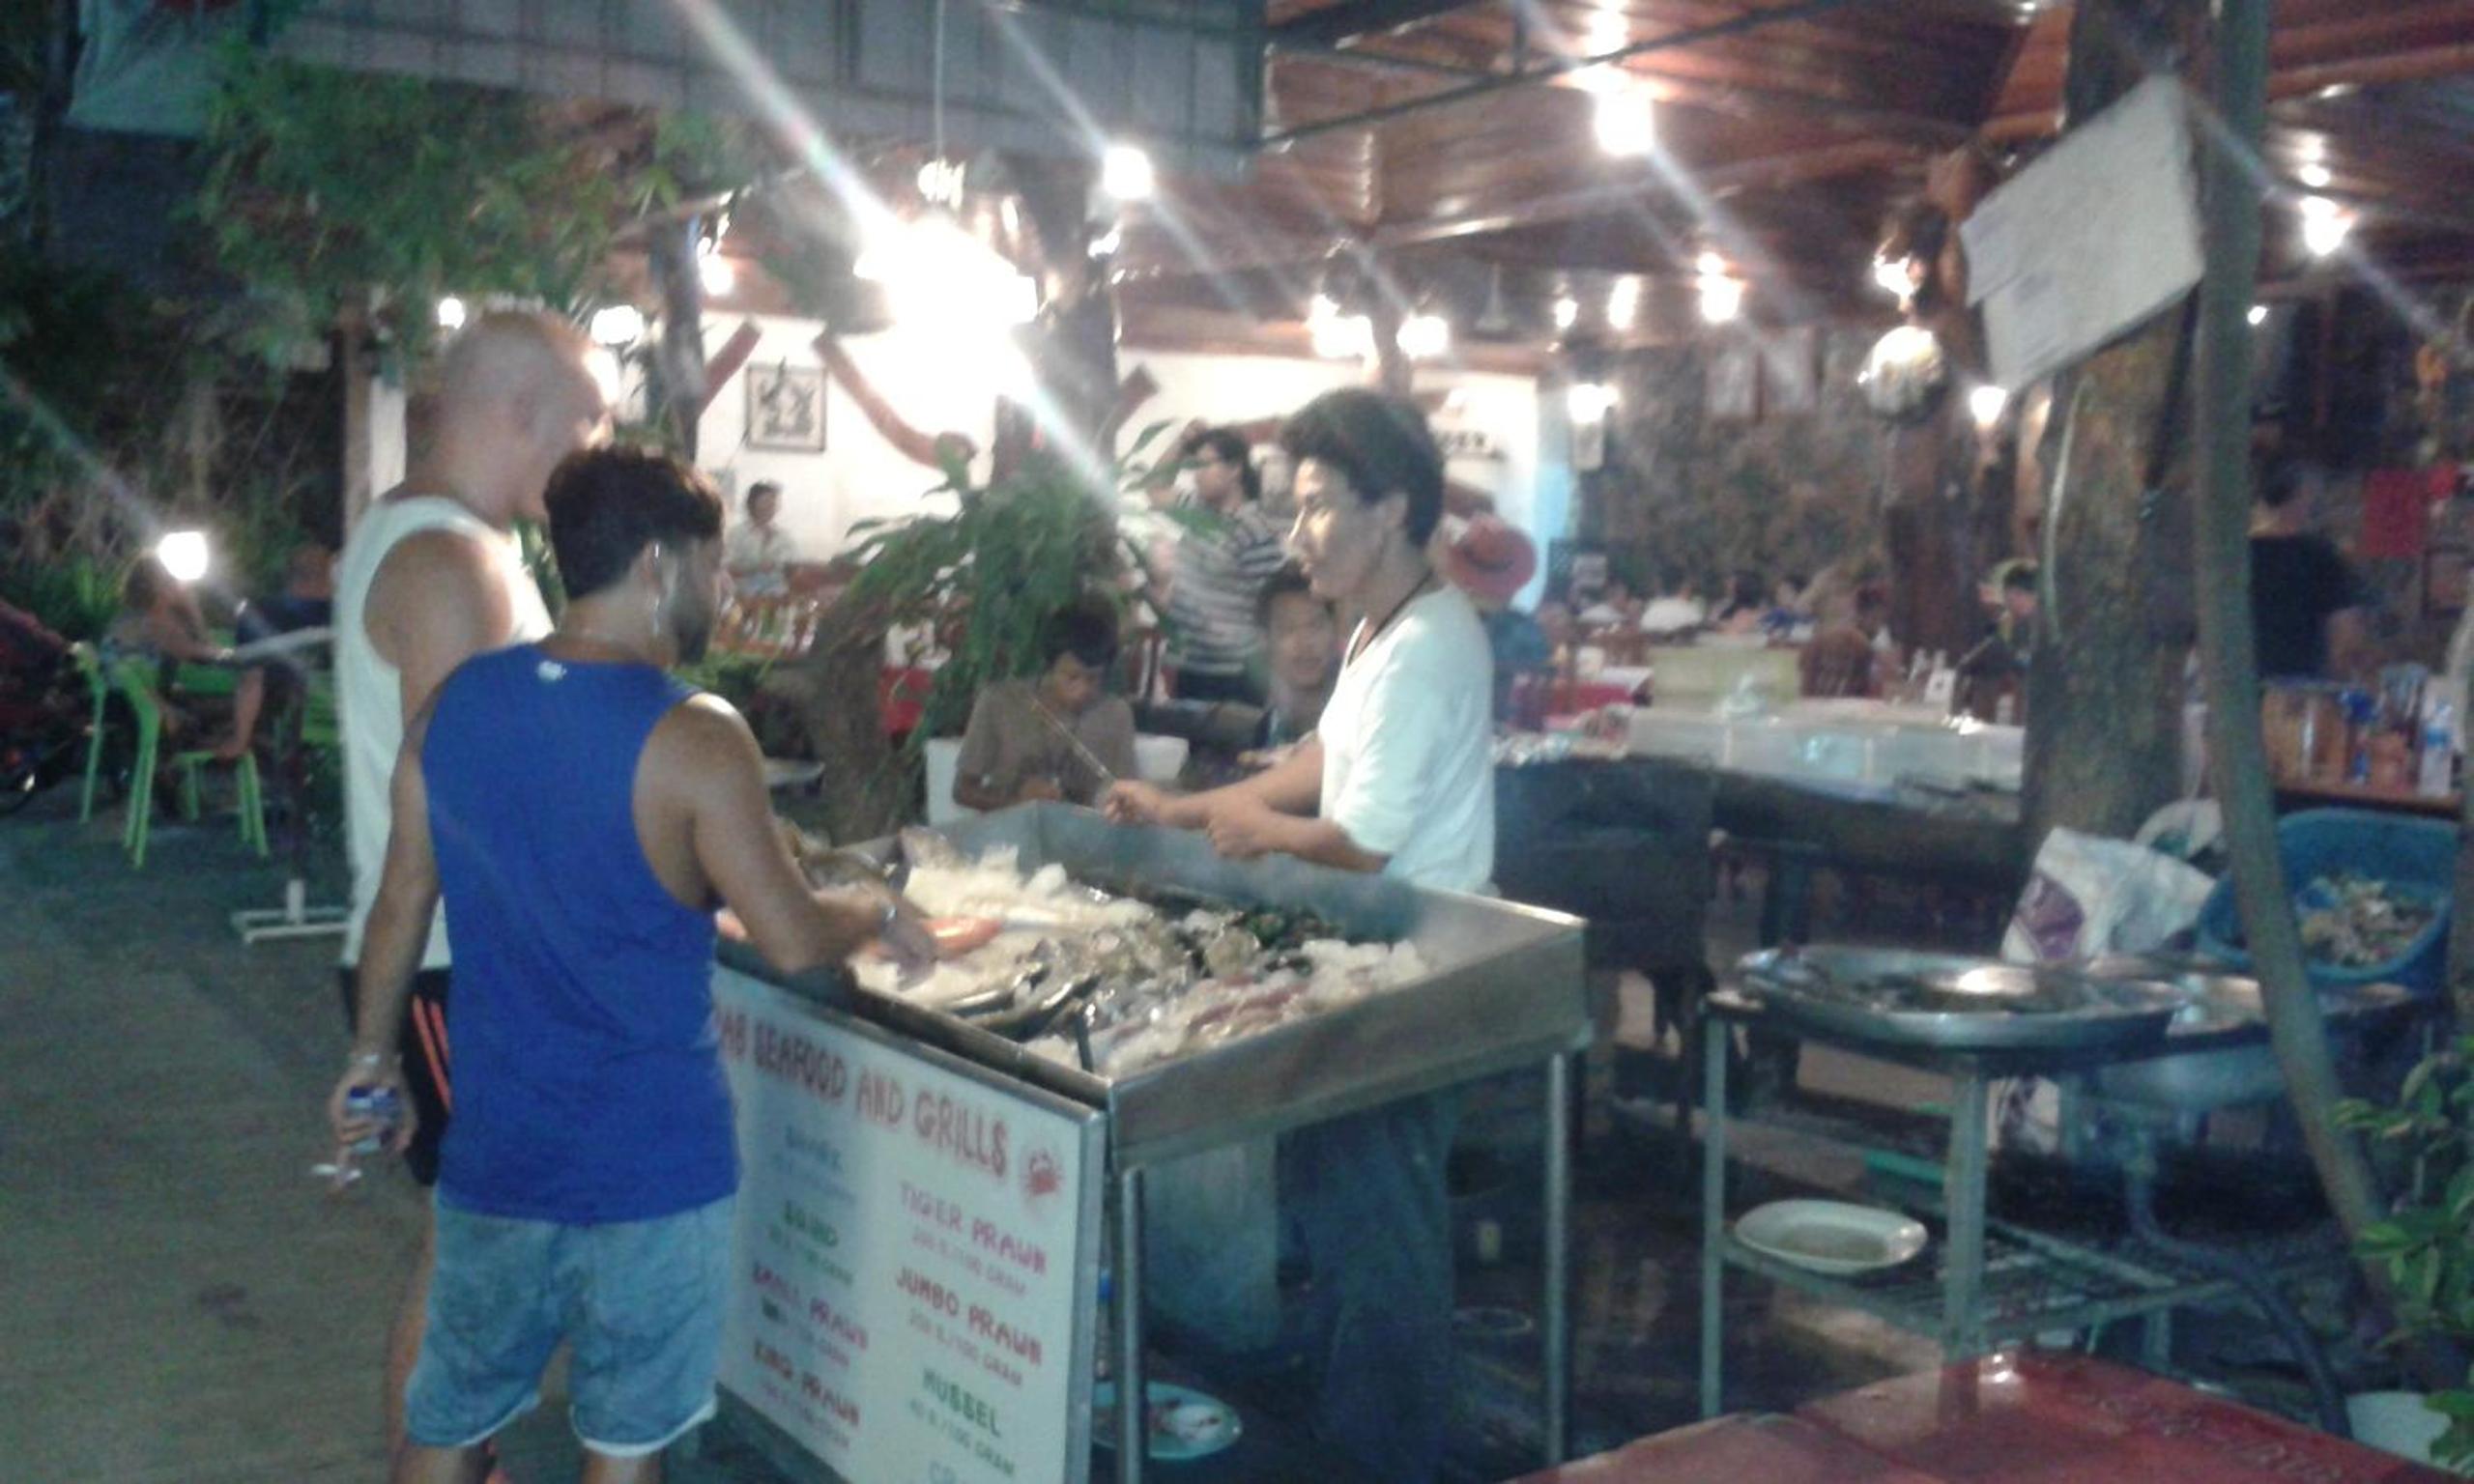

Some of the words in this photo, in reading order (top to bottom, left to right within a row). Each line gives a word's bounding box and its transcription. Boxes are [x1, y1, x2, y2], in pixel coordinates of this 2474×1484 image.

[856, 1070, 906, 1127] AND
[913, 1089, 1009, 1177] GRILLS
[971, 1215, 1048, 1274] PRAWN
[896, 1267, 960, 1317] JUMBO
[968, 1304, 1043, 1365] PRAWN
